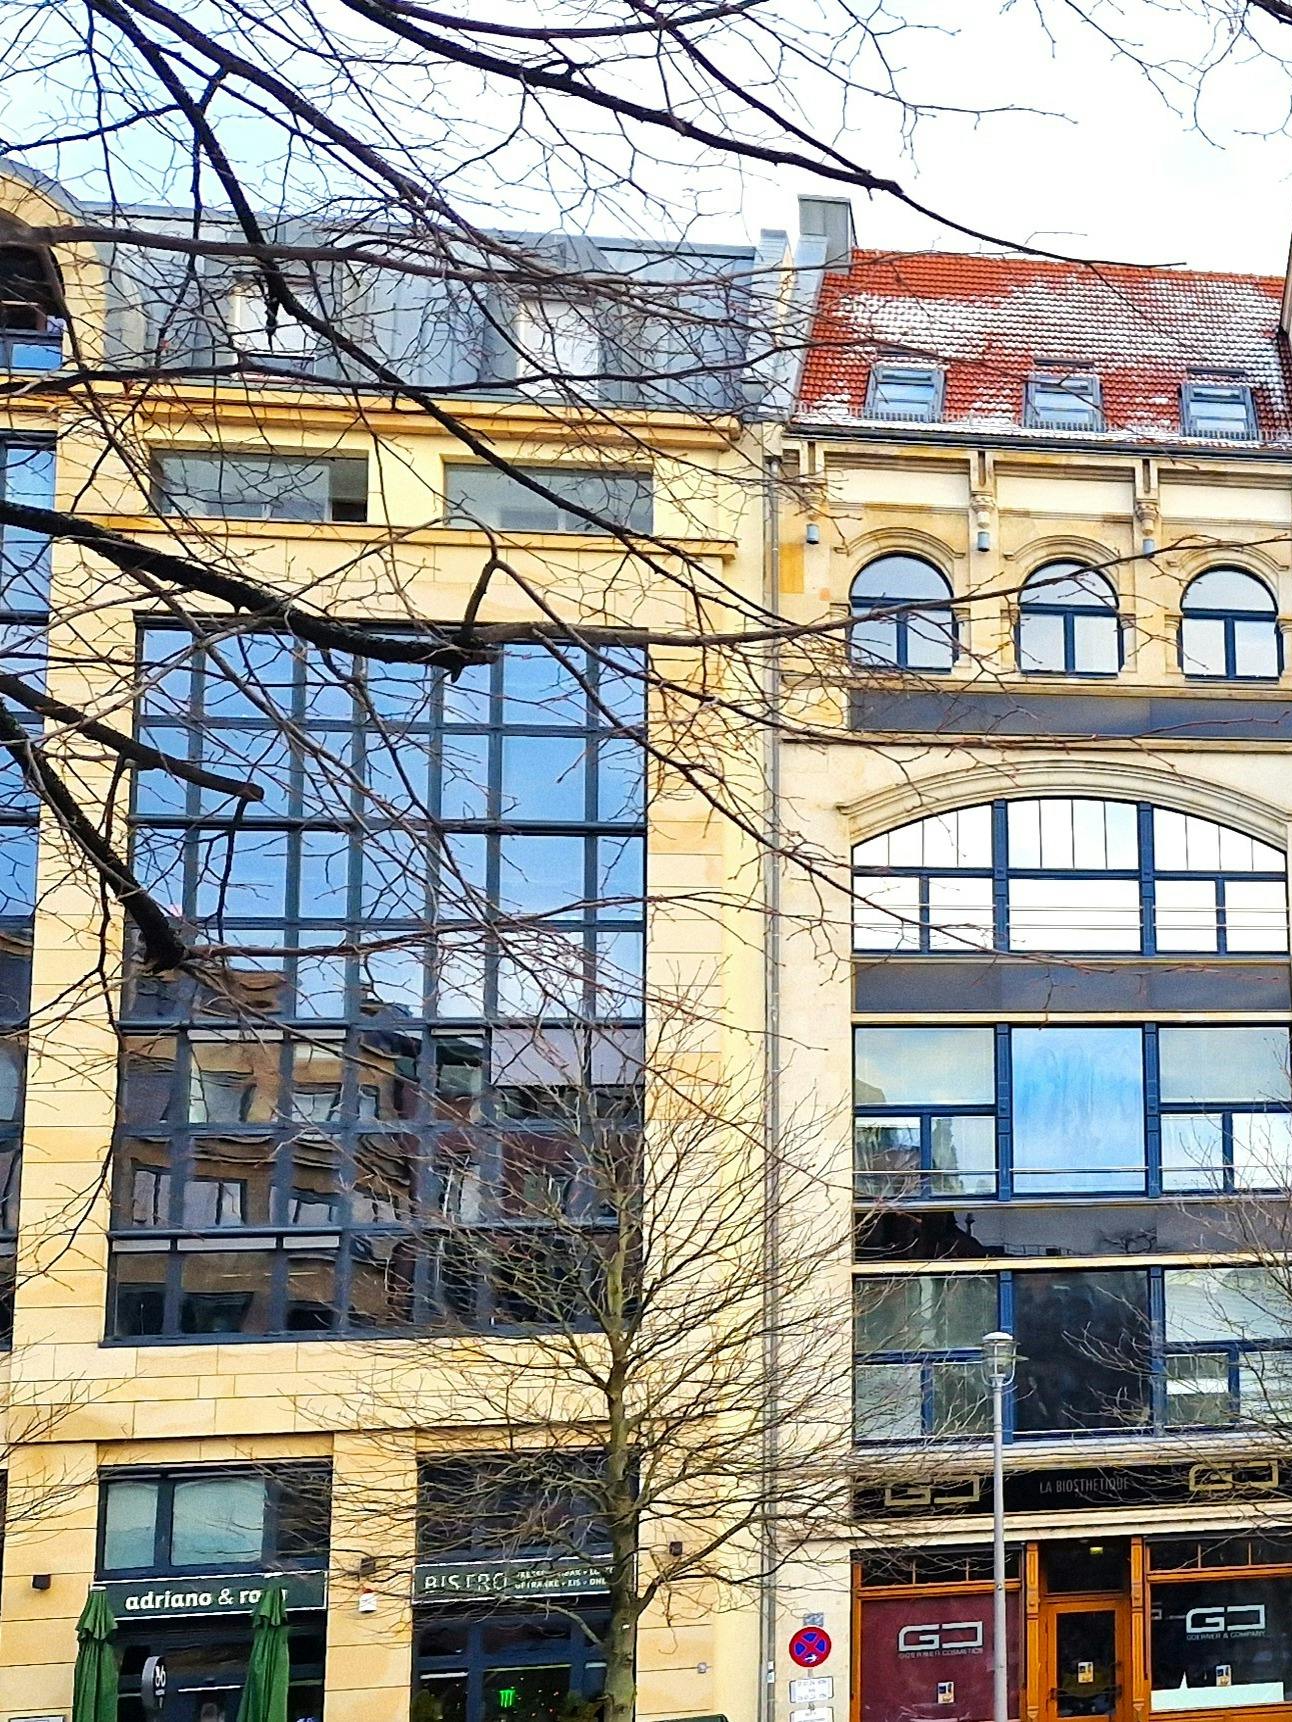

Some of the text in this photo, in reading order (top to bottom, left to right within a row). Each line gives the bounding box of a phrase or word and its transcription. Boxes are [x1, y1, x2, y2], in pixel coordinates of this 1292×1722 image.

[1040, 1476, 1129, 1494] LA BIOSTHETIQUE
[125, 1590, 211, 1610] adriano
[217, 1588, 234, 1605] &
